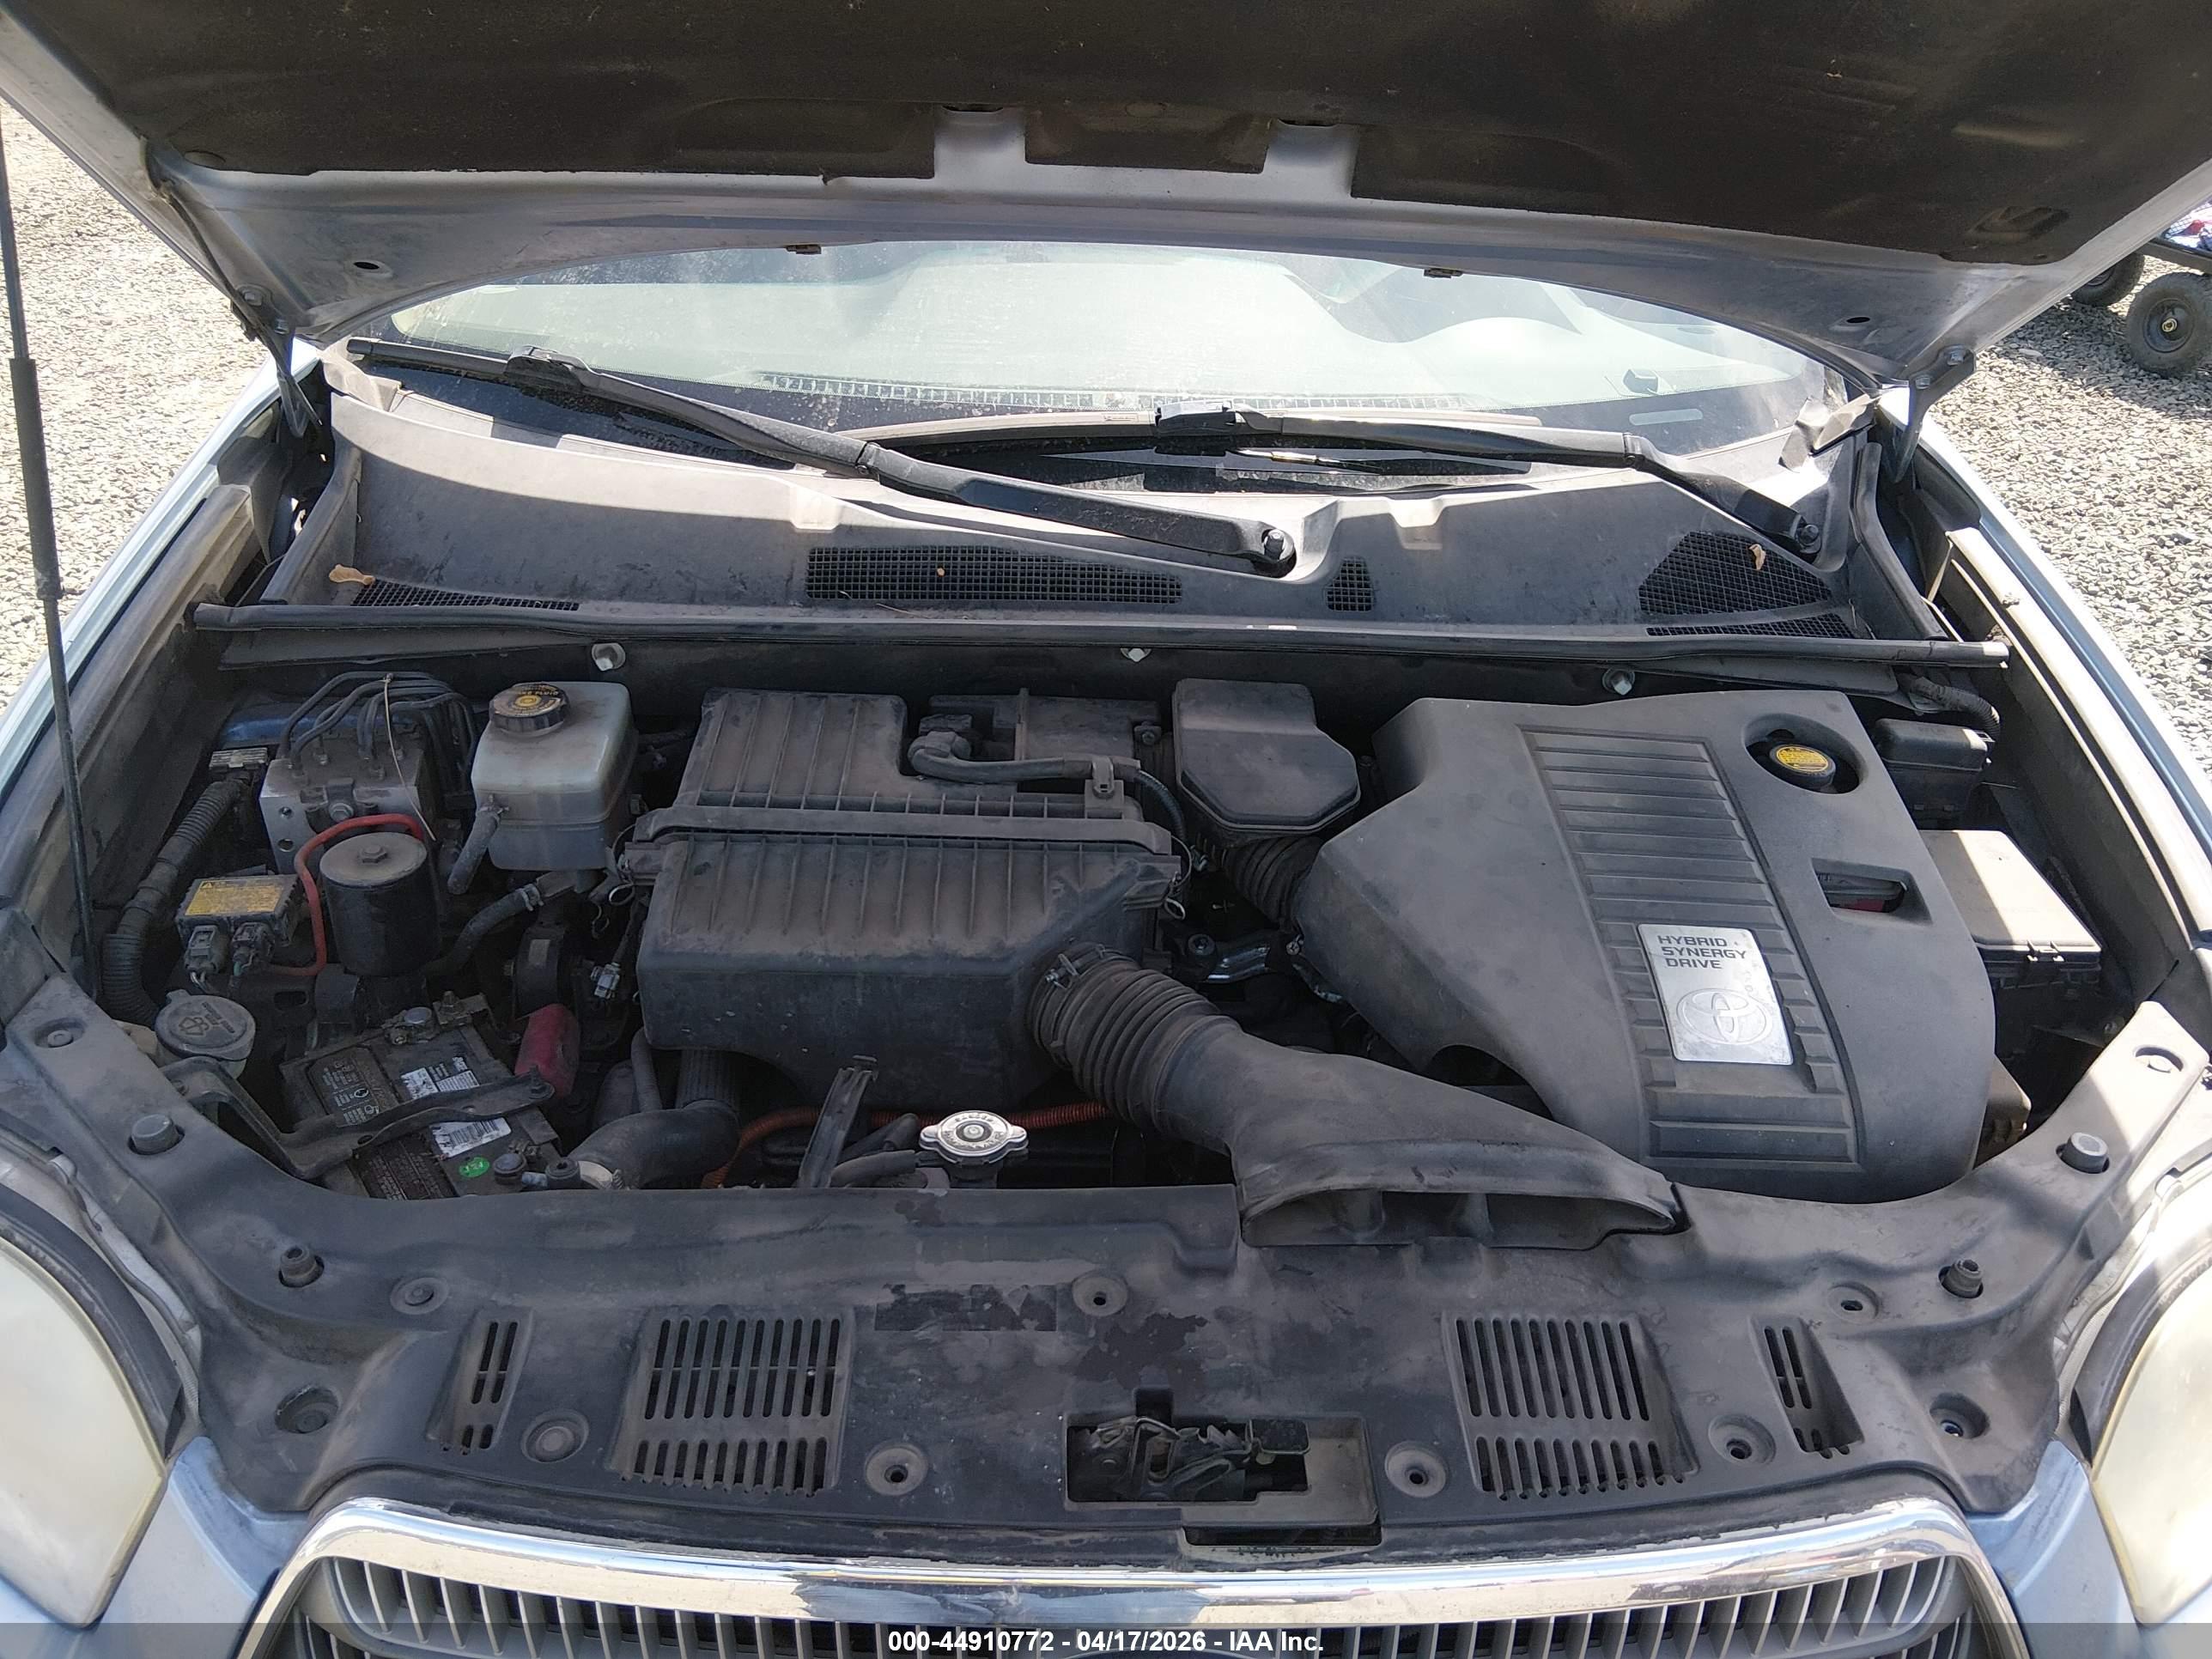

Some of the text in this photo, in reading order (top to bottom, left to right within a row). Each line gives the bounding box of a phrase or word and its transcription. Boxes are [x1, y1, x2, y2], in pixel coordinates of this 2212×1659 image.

[1657, 936, 1727, 946] HYBRID
[1662, 947, 1746, 959] SYNERGY
[1665, 958, 1722, 969] DRIVE
